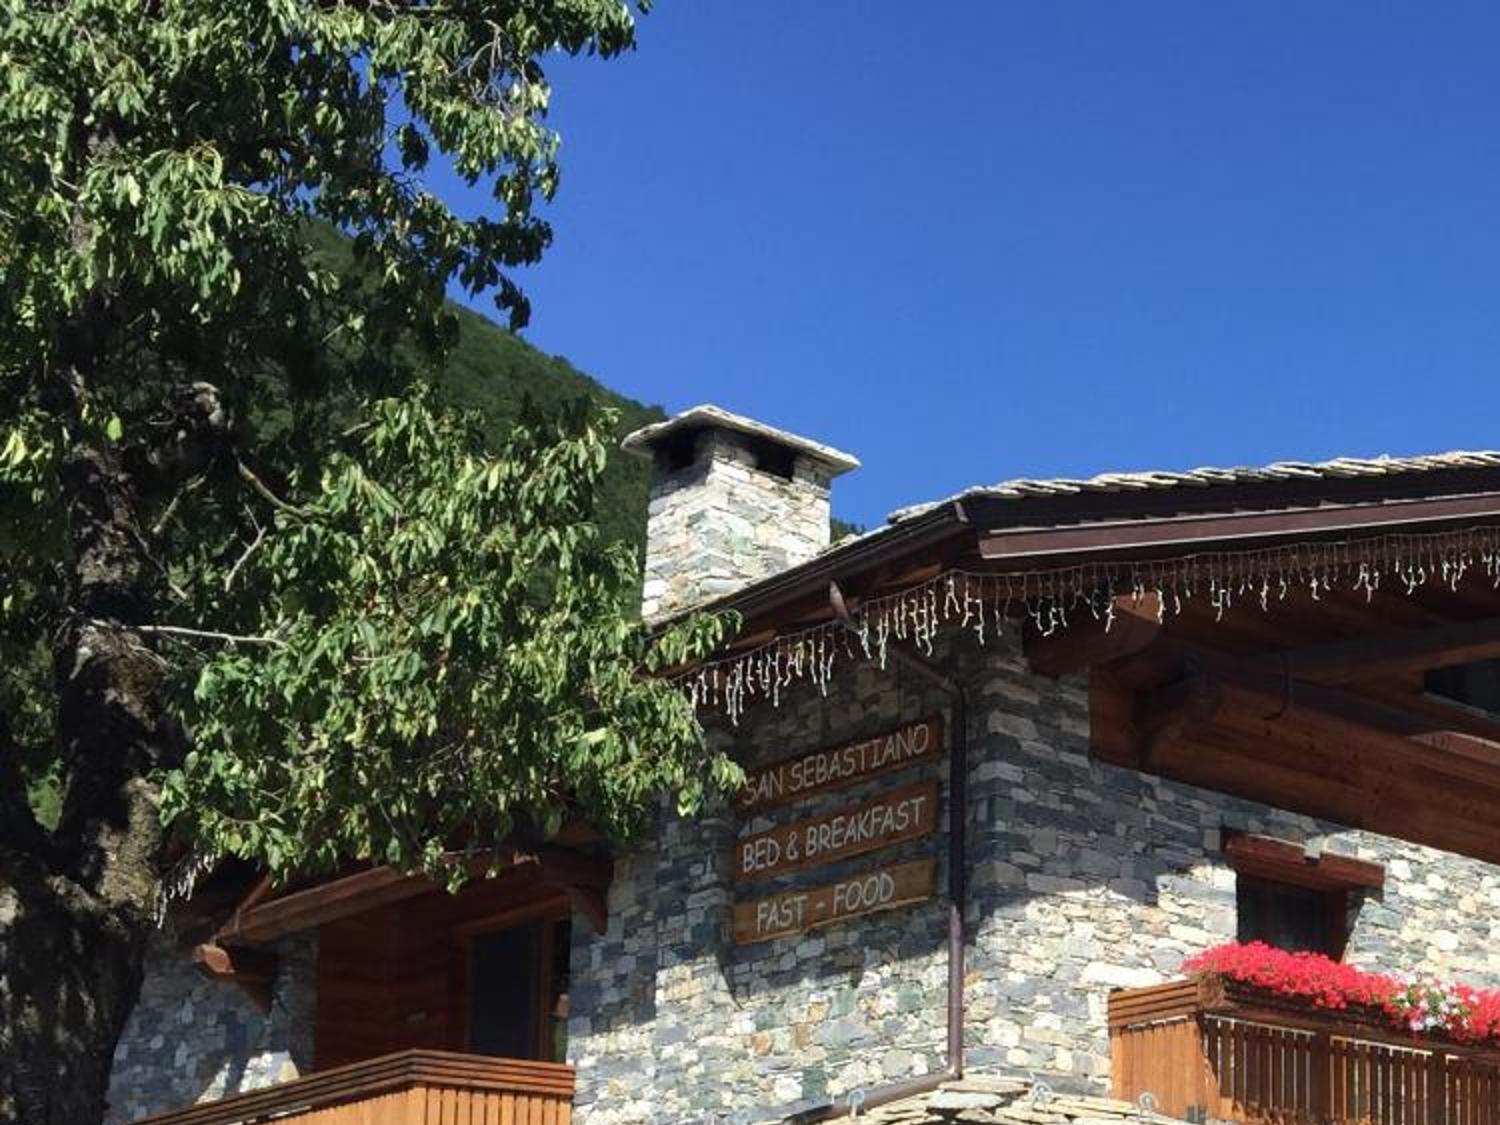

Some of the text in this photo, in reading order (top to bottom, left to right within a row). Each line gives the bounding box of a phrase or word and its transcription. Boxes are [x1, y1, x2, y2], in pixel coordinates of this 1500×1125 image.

[743, 724, 928, 805] SAN SEBASTIANO
[743, 797, 926, 872] BED & BREAKFAST
[757, 896, 808, 932] FAST
[832, 873, 895, 914] FOOD
